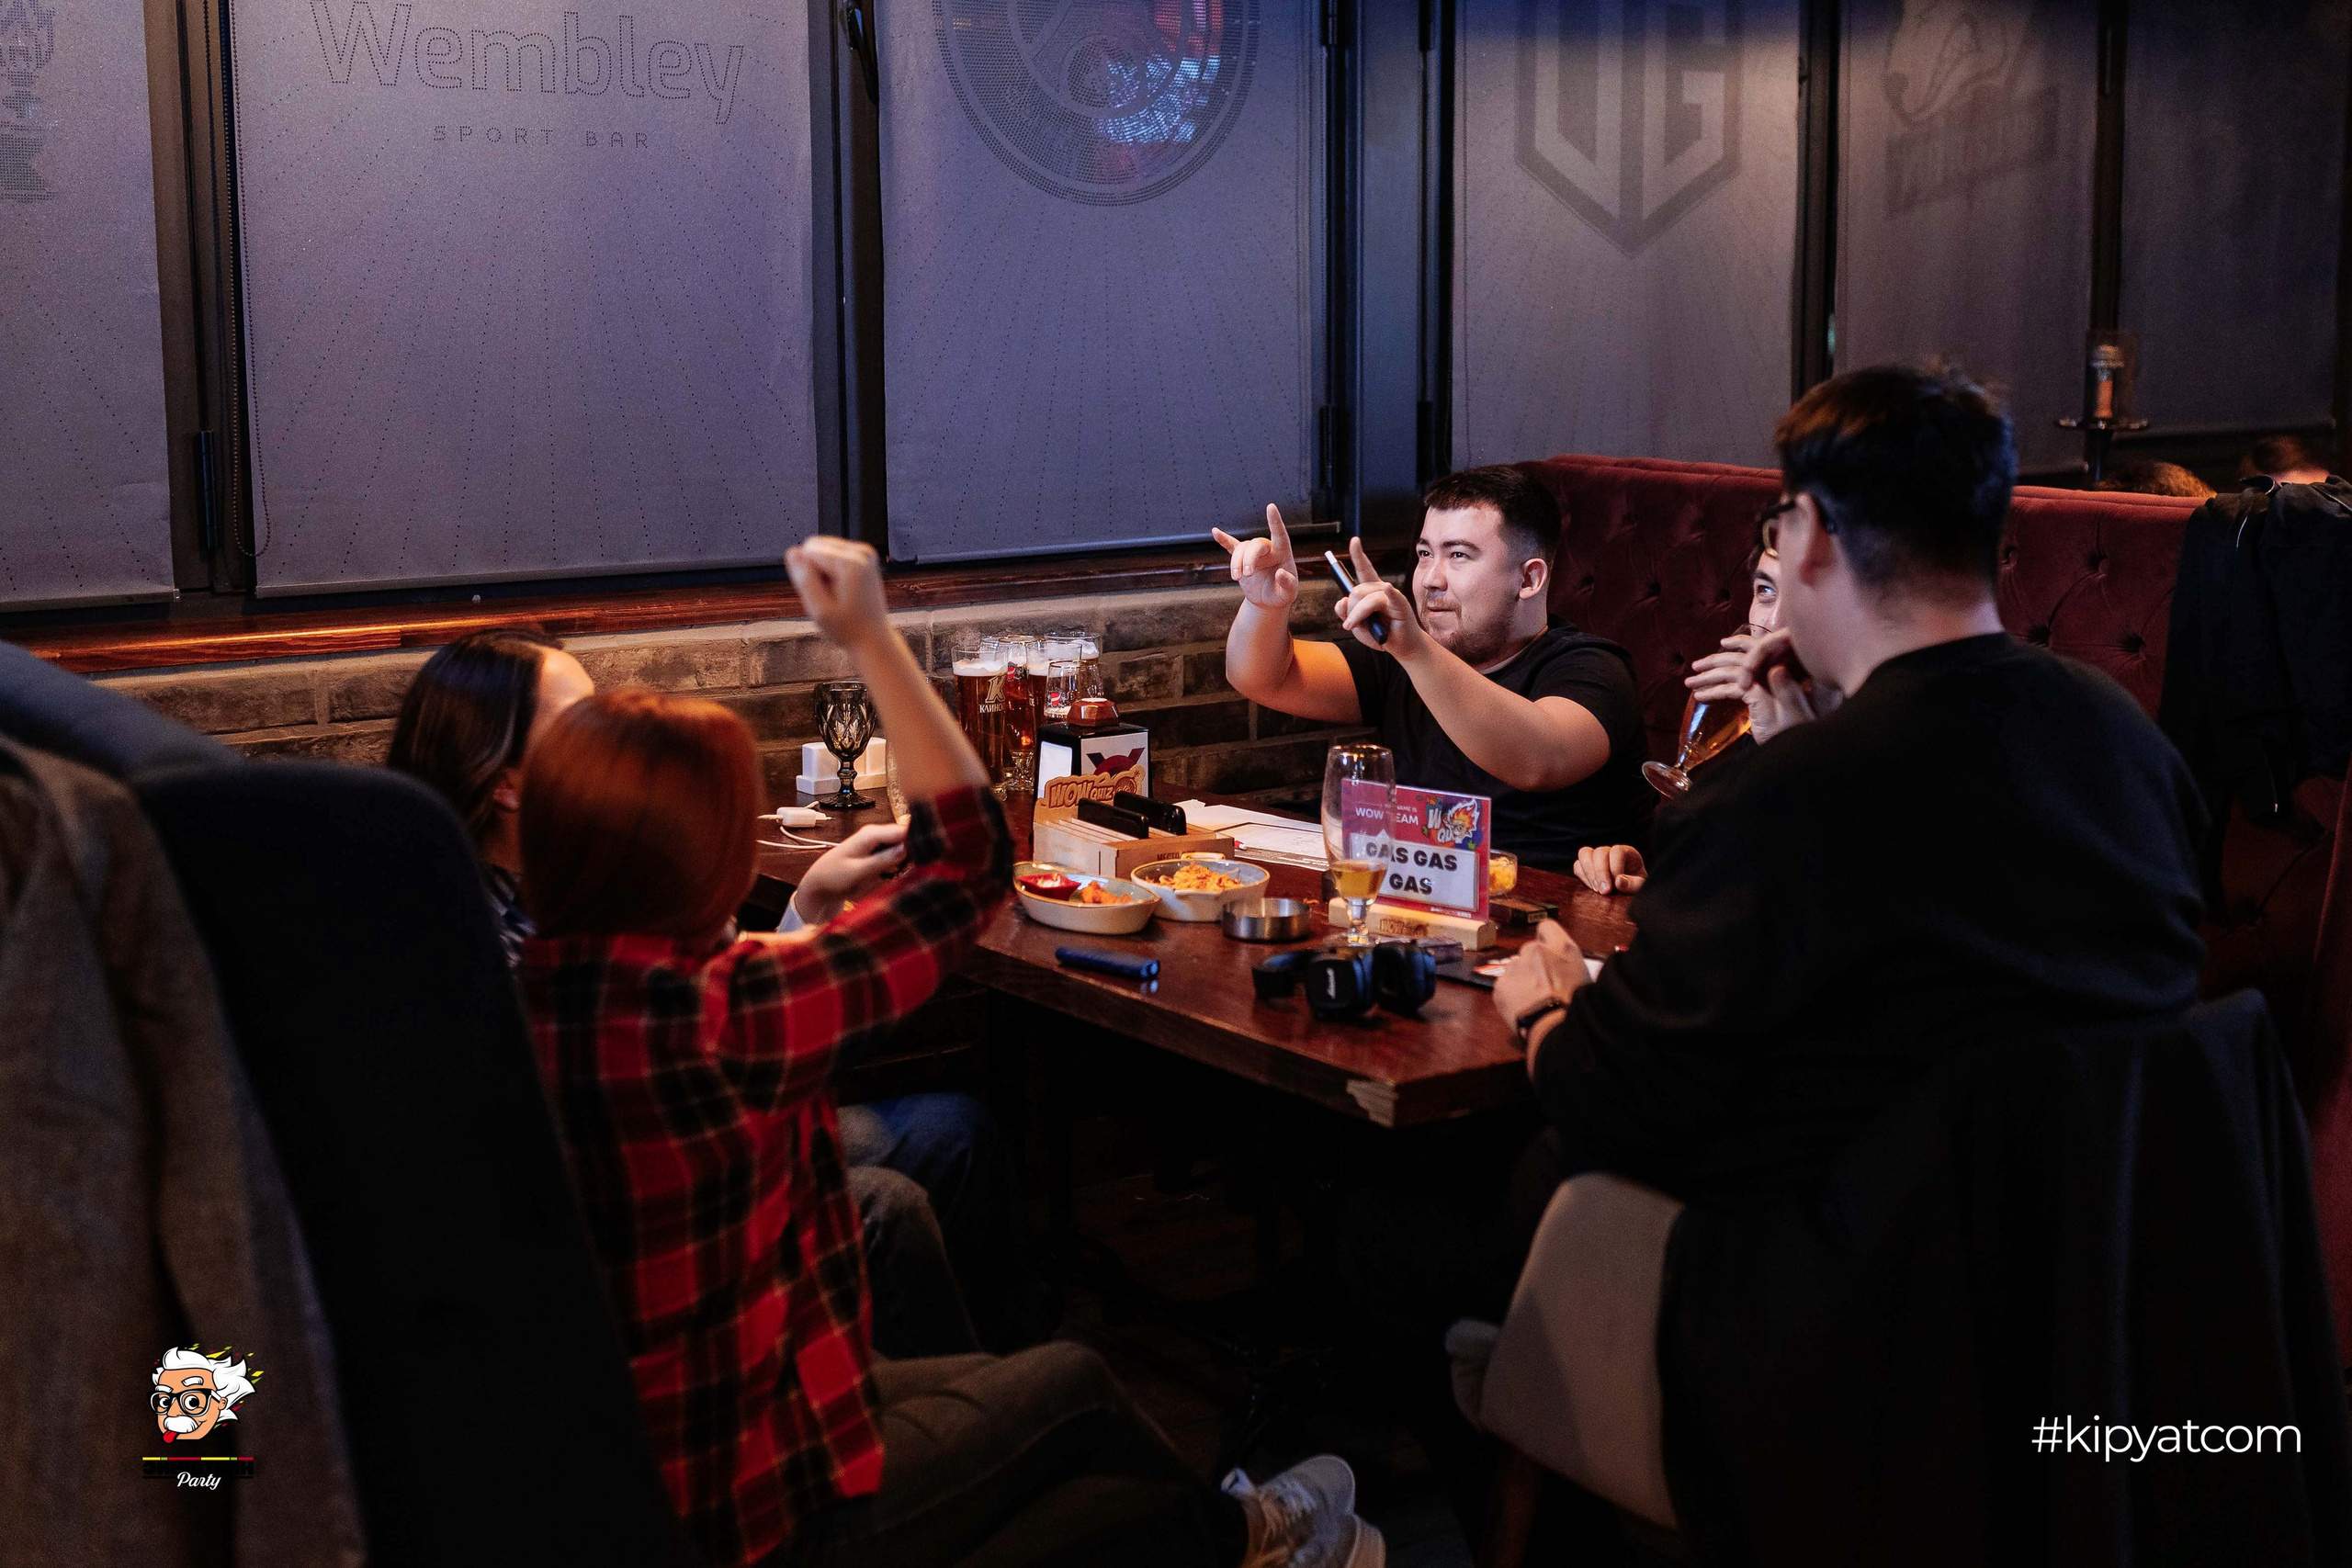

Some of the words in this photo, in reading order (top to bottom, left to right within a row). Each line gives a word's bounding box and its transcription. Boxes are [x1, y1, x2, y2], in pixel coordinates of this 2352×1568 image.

[310, 0, 745, 126] Wembley
[433, 125, 554, 145] SPORT
[585, 130, 649, 150] BAR
[978, 704, 1003, 714] КЛИНС
[1048, 780, 1094, 808] WOW
[1091, 786, 1114, 801] QUIZ
[1355, 807, 1385, 821] WOW
[1365, 842, 1408, 864] GAS
[1413, 851, 1457, 872] GAS
[1389, 874, 1432, 895] GAS
